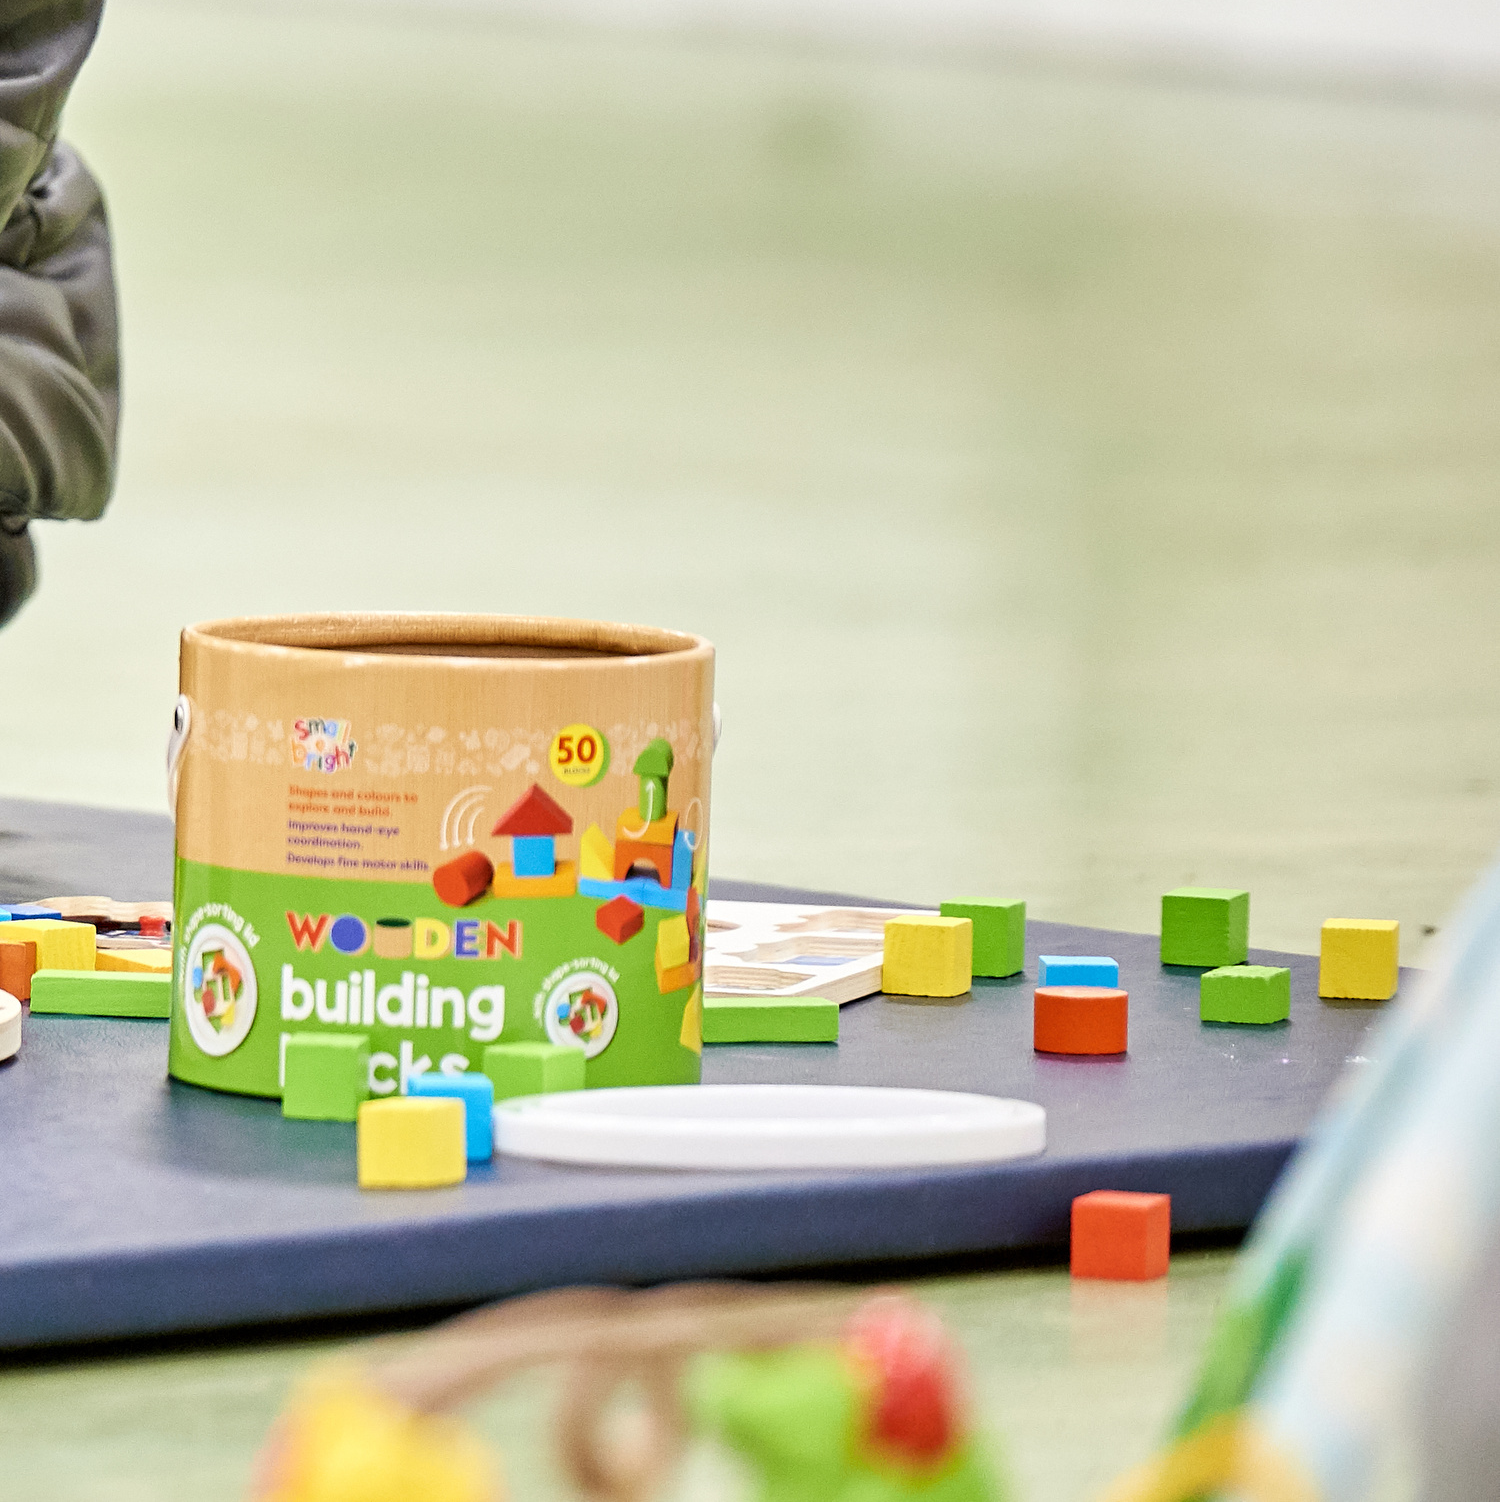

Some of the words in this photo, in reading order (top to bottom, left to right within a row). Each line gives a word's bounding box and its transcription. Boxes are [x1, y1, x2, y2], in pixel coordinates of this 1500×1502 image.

[291, 738, 356, 773] bright
[557, 734, 597, 765] 50
[289, 784, 328, 800] Shapes
[331, 789, 354, 800] and
[357, 790, 400, 804] colours
[403, 793, 419, 804] to
[288, 802, 330, 815] explore
[332, 805, 356, 815] and
[288, 819, 339, 833] Improves
[287, 852, 336, 869] Develops
[338, 856, 360, 869] fine
[361, 859, 397, 871] motor
[280, 963, 506, 1042] building
